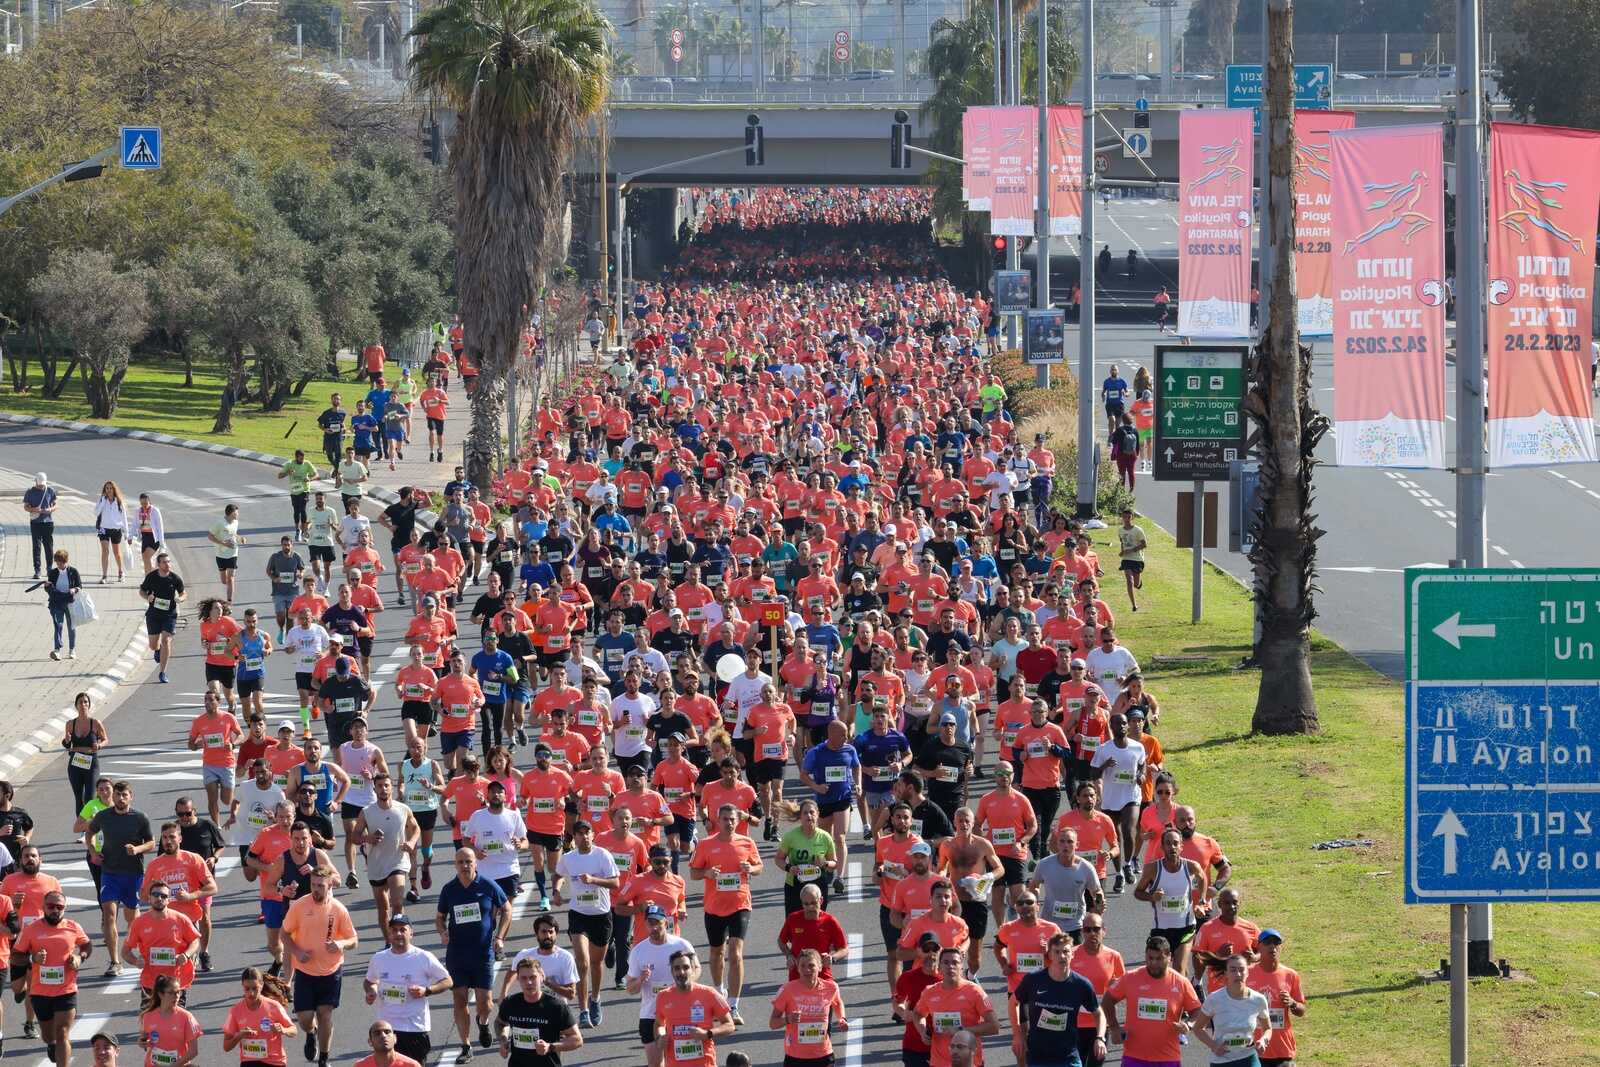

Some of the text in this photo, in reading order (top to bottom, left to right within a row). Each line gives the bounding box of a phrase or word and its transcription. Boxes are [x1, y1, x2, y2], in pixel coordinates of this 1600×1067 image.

[1517, 255, 1571, 277] מרתון
[1519, 283, 1586, 304] Playtika
[1504, 333, 1581, 352] 24.2.2023
[1177, 427, 1194, 436] Expo
[765, 610, 780, 620] 50
[1499, 704, 1578, 729] דרום
[1472, 741, 1592, 771] Ayalon
[1514, 811, 1593, 840] צפון
